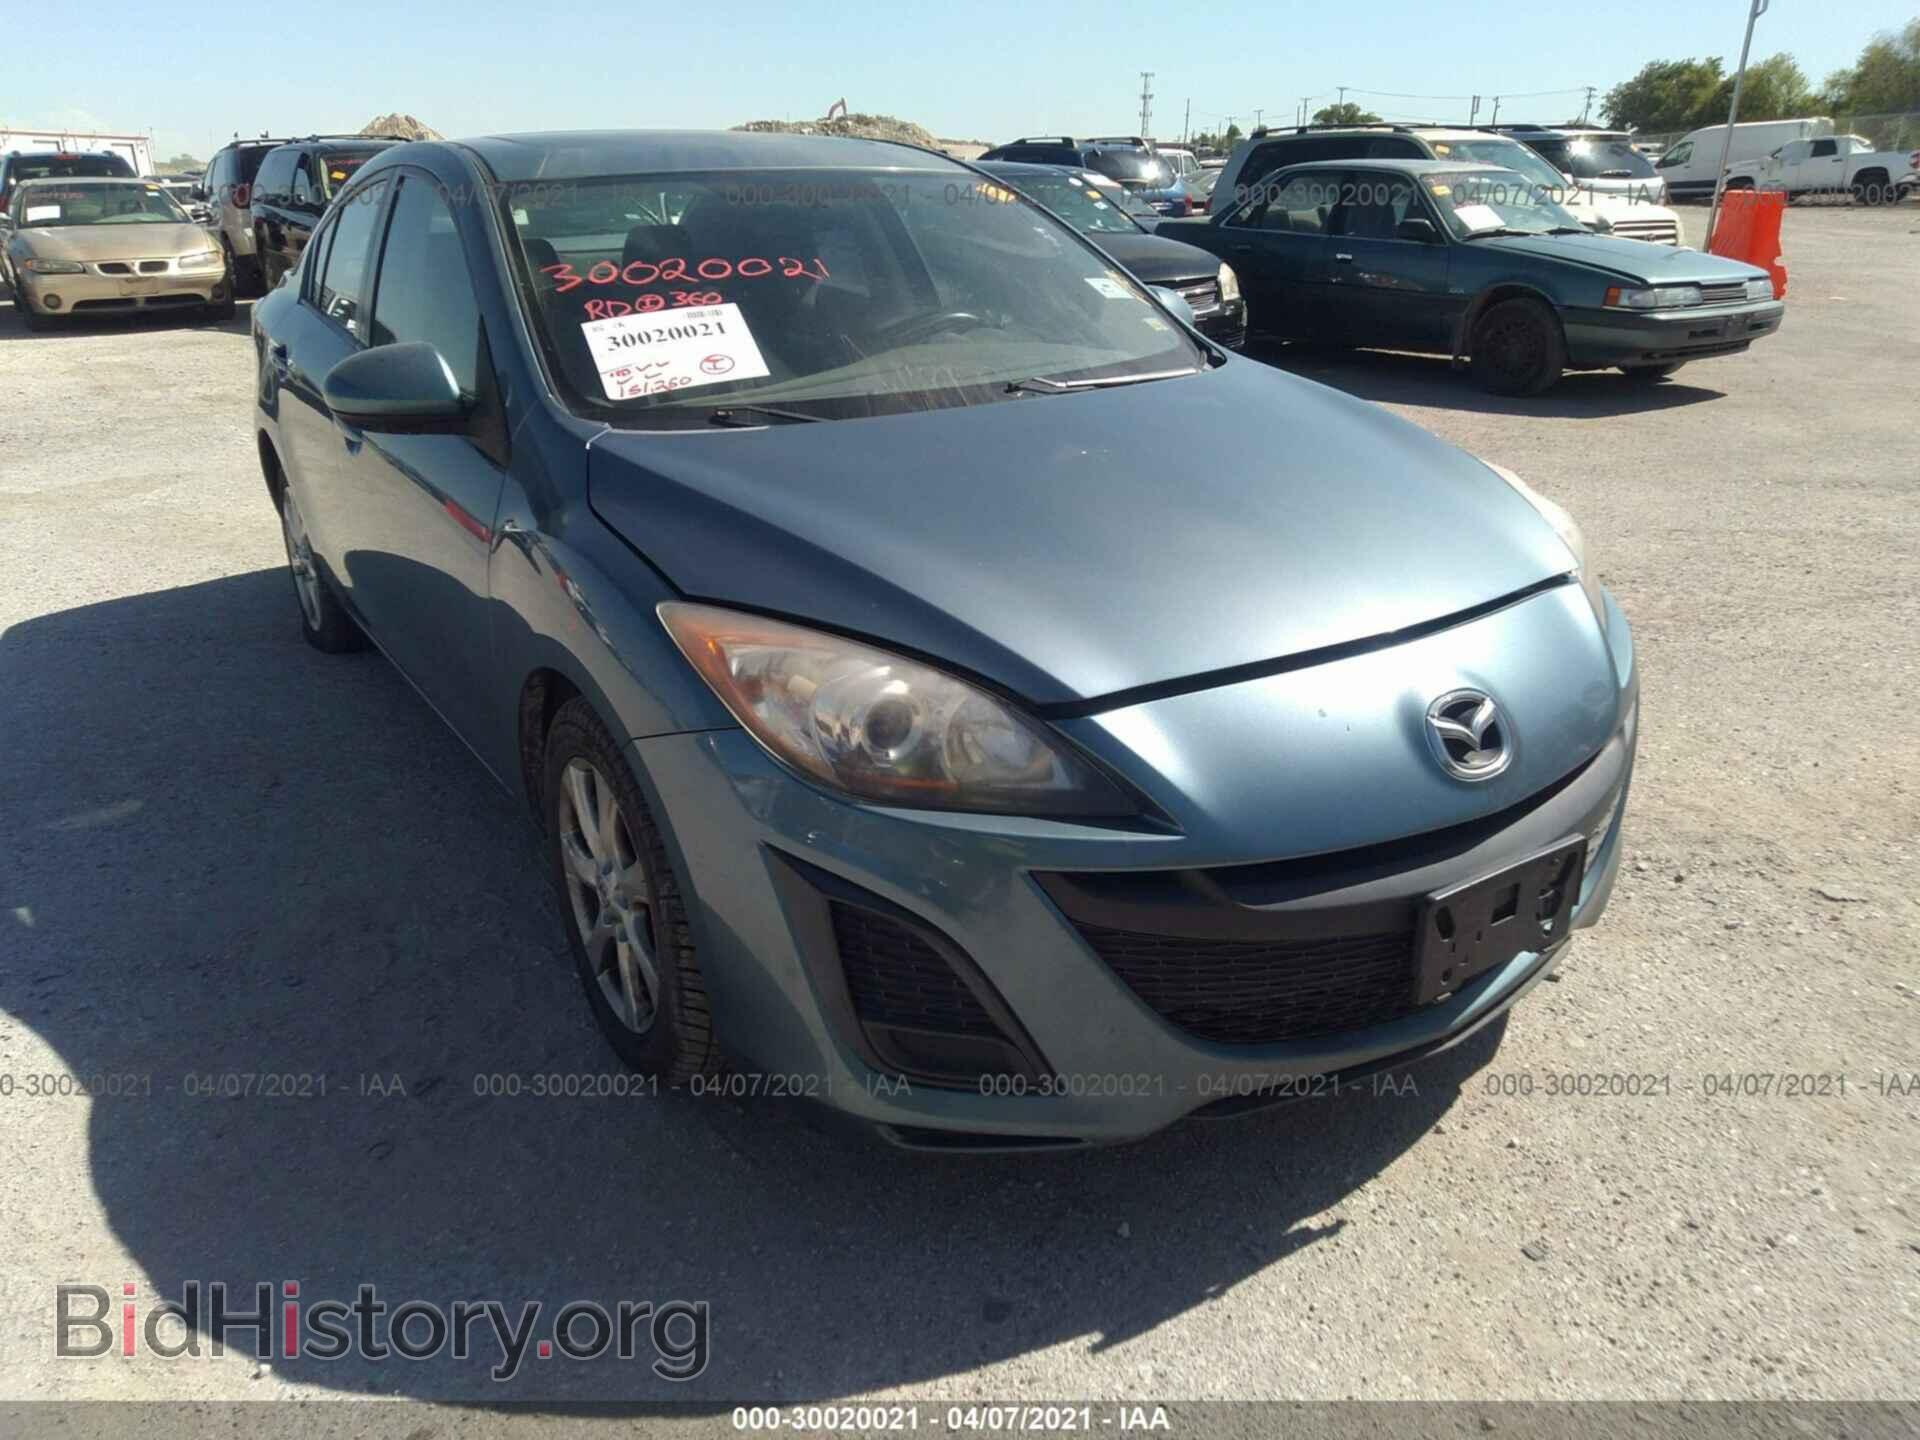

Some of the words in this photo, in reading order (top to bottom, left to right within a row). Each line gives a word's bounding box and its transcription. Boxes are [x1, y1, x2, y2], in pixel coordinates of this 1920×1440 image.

[539, 257, 830, 293] 30020021
[584, 299, 628, 320] RD
[606, 321, 727, 352] 30020021
